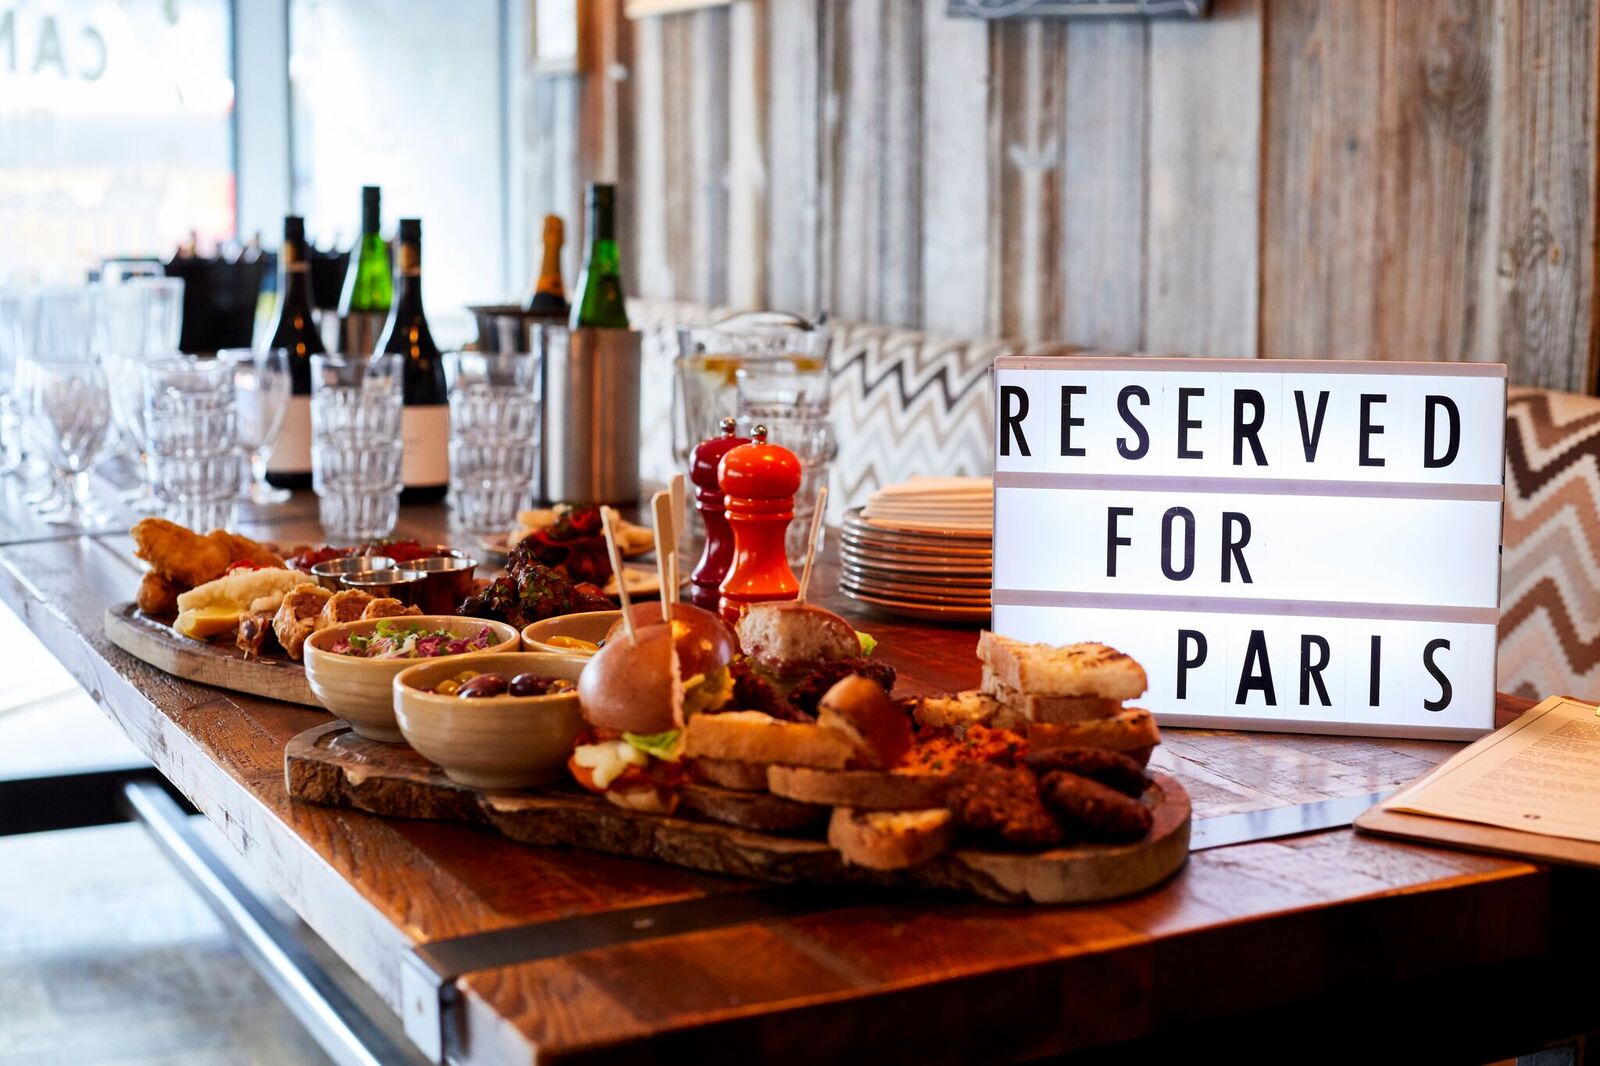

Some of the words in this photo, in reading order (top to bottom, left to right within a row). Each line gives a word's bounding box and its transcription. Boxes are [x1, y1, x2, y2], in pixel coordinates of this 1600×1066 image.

[1000, 385, 1461, 469] RESERVED
[1106, 506, 1253, 584] FOR
[1176, 629, 1452, 712] PARIS
